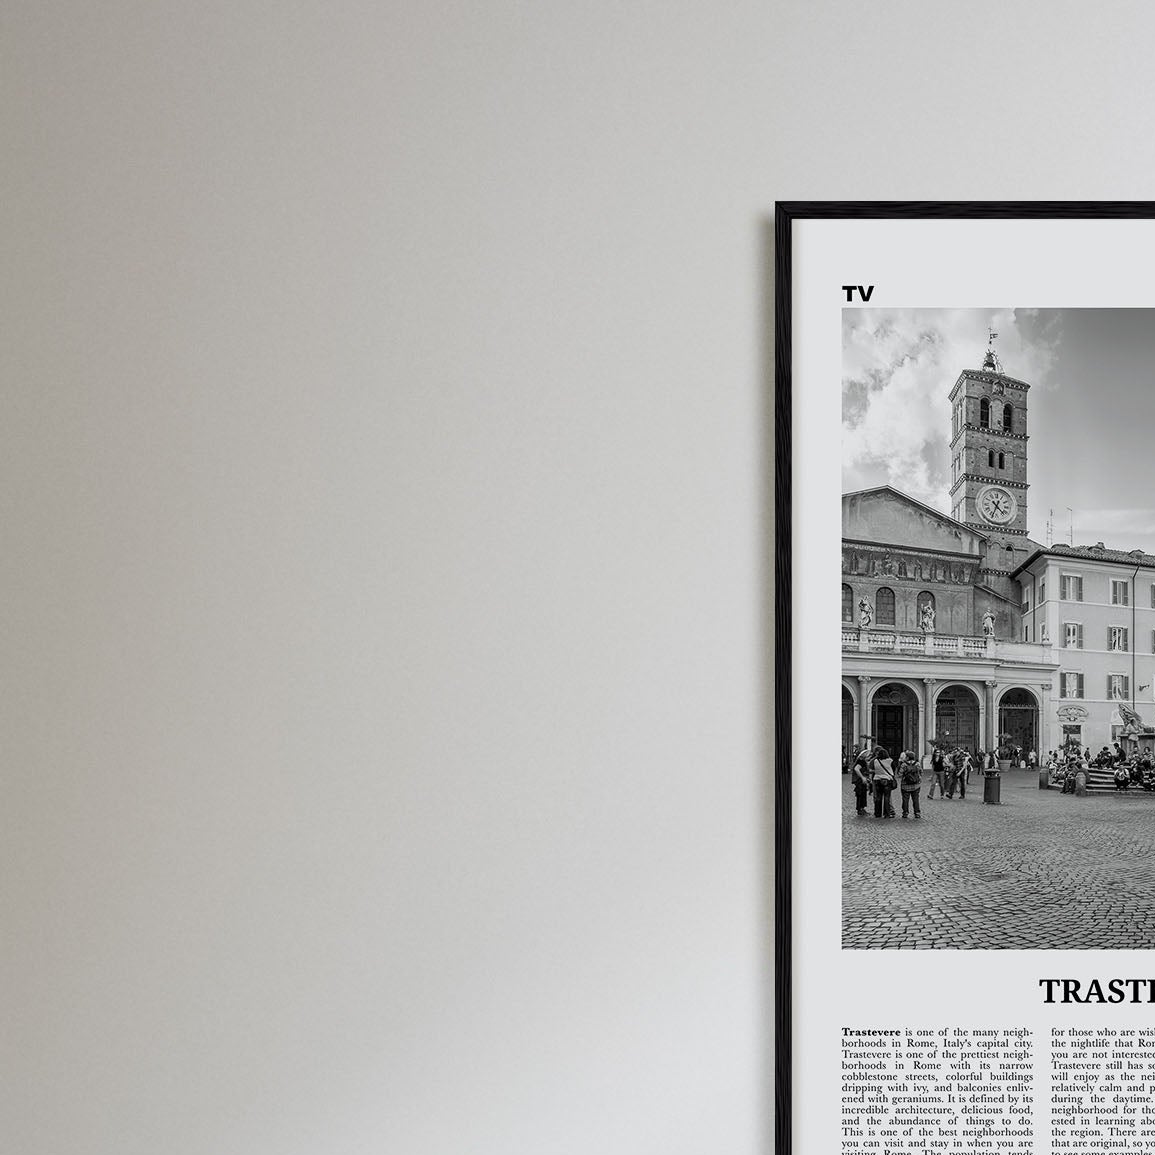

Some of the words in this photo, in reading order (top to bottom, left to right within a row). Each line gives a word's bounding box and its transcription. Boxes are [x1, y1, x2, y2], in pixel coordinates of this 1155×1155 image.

[842, 286, 875, 302] TV
[842, 1028, 901, 1036] Trastevere
[905, 1028, 912, 1036] is
[938, 1028, 949, 1036] of
[954, 1028, 968, 1036] the
[973, 1030, 999, 1039] many
[1003, 1028, 1033, 1039] neigh-
[1052, 1028, 1065, 1036] for
[1069, 1028, 1093, 1036] those
[1097, 1028, 1117, 1036] who
[842, 1039, 886, 1047] borhoods
[892, 1039, 901, 1047] in
[907, 1039, 937, 1049] Rome,
[944, 1039, 971, 1050] Italy's
[977, 1039, 1008, 1050] capital
[1014, 1039, 1032, 1050] city.
[842, 1050, 891, 1058] Trastevere
[896, 1050, 902, 1058] is
[927, 1050, 938, 1058] of
[942, 1050, 956, 1058] the
[961, 1050, 999, 1061] prettiest
[1004, 1050, 1033, 1061] neigh-
[842, 1061, 886, 1069] borhoods
[895, 1061, 904, 1069] in
[914, 1061, 941, 1069] Rome
[950, 1061, 970, 1069] with
[980, 1061, 990, 1069] its
[1051, 1061, 1101, 1069] Trastevere
[1106, 1061, 1122, 1069] still
[1128, 1061, 1143, 1069] has
[842, 1072, 898, 1080] cobblestone
[905, 1073, 938, 1082] streets,
[946, 1072, 982, 1080] colorful
[990, 1072, 1033, 1083] buildings
[1051, 1072, 1068, 1080] will
[1074, 1072, 1099, 1083] enjoy
[1121, 1072, 1135, 1080] the
[842, 1083, 882, 1094] dripping
[888, 1083, 908, 1091] with
[914, 1083, 929, 1094] ivy,
[934, 1083, 952, 1091] and
[957, 1083, 1001, 1091] balconies
[1007, 1083, 1033, 1091] enliv-
[1052, 1083, 1095, 1094] relatively
[1099, 1083, 1122, 1091] calm
[1127, 1083, 1145, 1091] and
[842, 1105, 889, 1113] incredible
[895, 1105, 955, 1115] architecture,
[961, 1105, 1003, 1113] delicious
[1009, 1105, 1033, 1115] food,
[1052, 1105, 1118, 1116] neighborhood
[1123, 1105, 1136, 1113] for
[842, 1127, 863, 1136] This
[869, 1127, 875, 1136] is
[903, 1127, 913, 1136] of
[919, 1127, 933, 1136] the
[939, 1127, 957, 1136] best
[963, 1127, 1033, 1138] neighborhoods
[1052, 1127, 1066, 1136] the
[1071, 1127, 1103, 1138] region.
[1108, 1127, 1136, 1136] There
